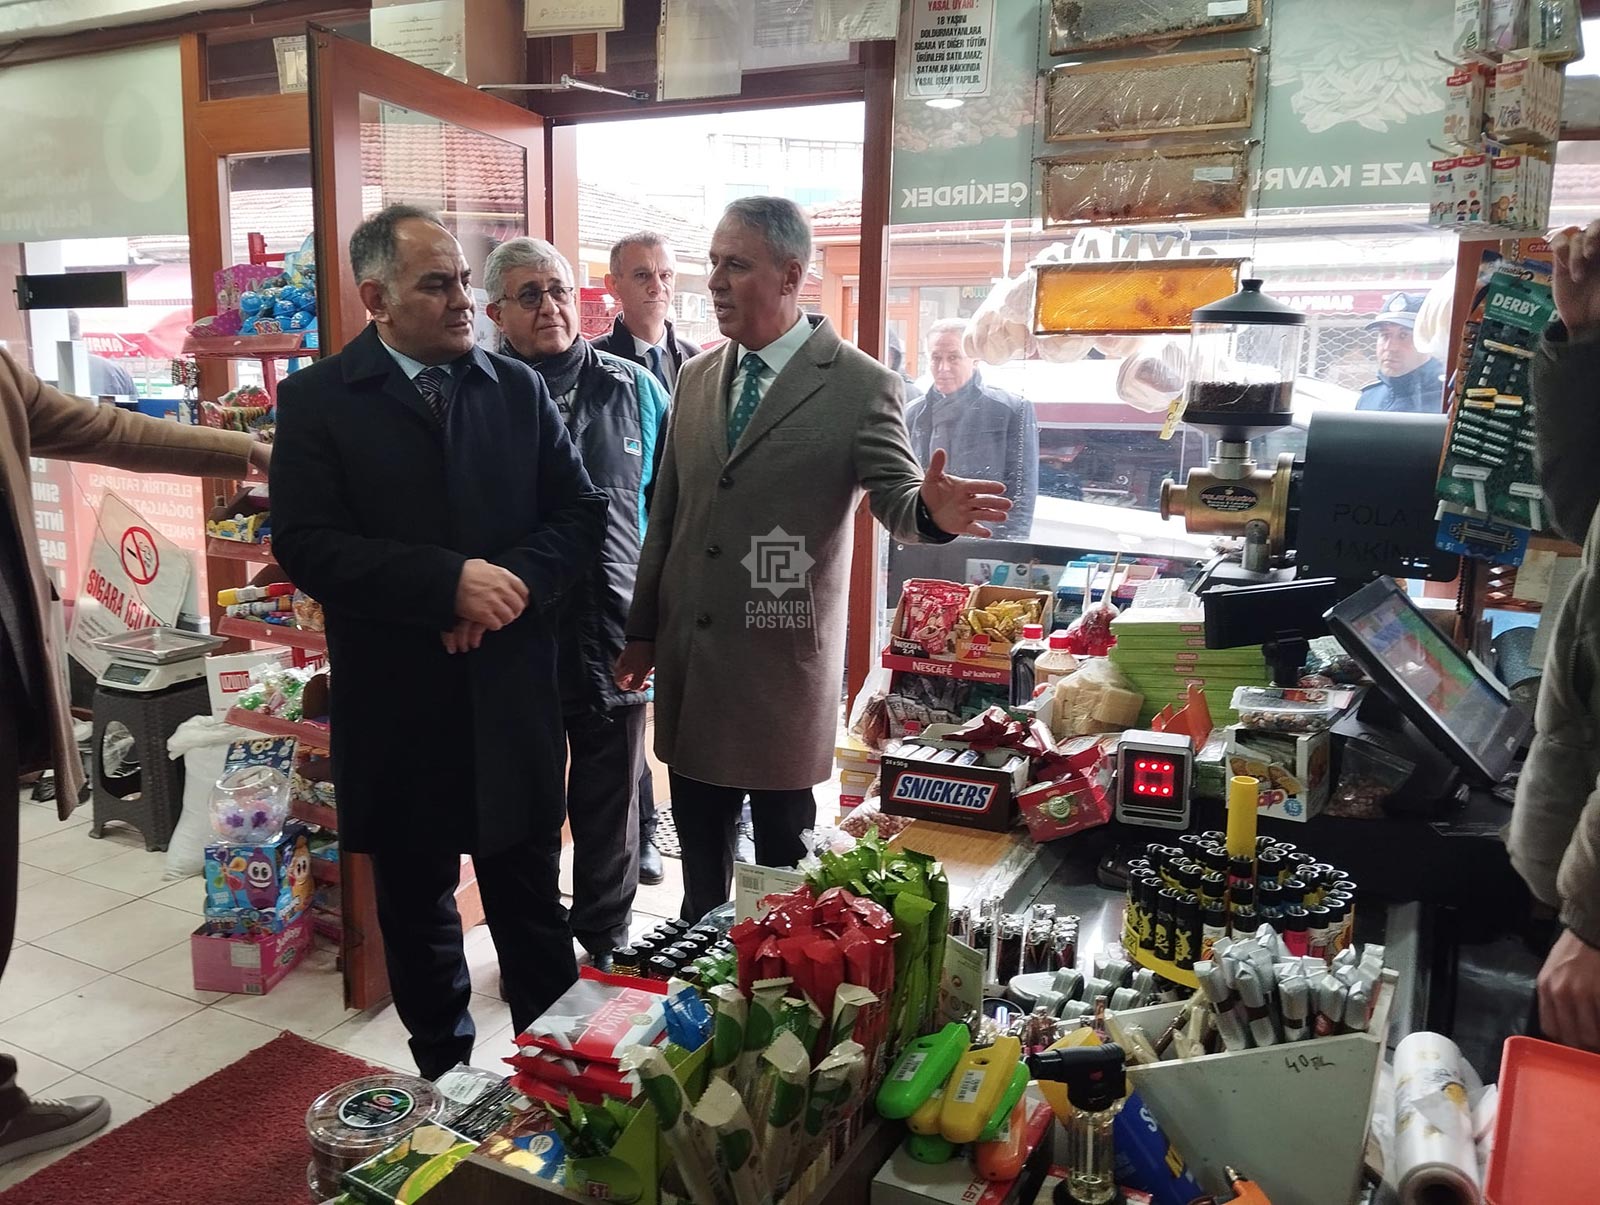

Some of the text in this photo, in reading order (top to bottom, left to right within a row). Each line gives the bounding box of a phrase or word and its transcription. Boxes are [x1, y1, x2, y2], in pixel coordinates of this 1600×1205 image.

[937, 15, 946, 25] 18
[920, 26, 982, 38] DOLDURMAYANLARA
[938, 40, 946, 49] VE
[917, 63, 981, 74] SATANLAR HAKKINDA
[1491, 293, 1541, 317] DERBY
[1332, 503, 1430, 528] POLAT
[87, 569, 125, 618] SİGARA
[912, 661, 953, 676] NESCAFÉ
[897, 776, 992, 809] SNICKERS
[1285, 1054, 1309, 1073] 40
